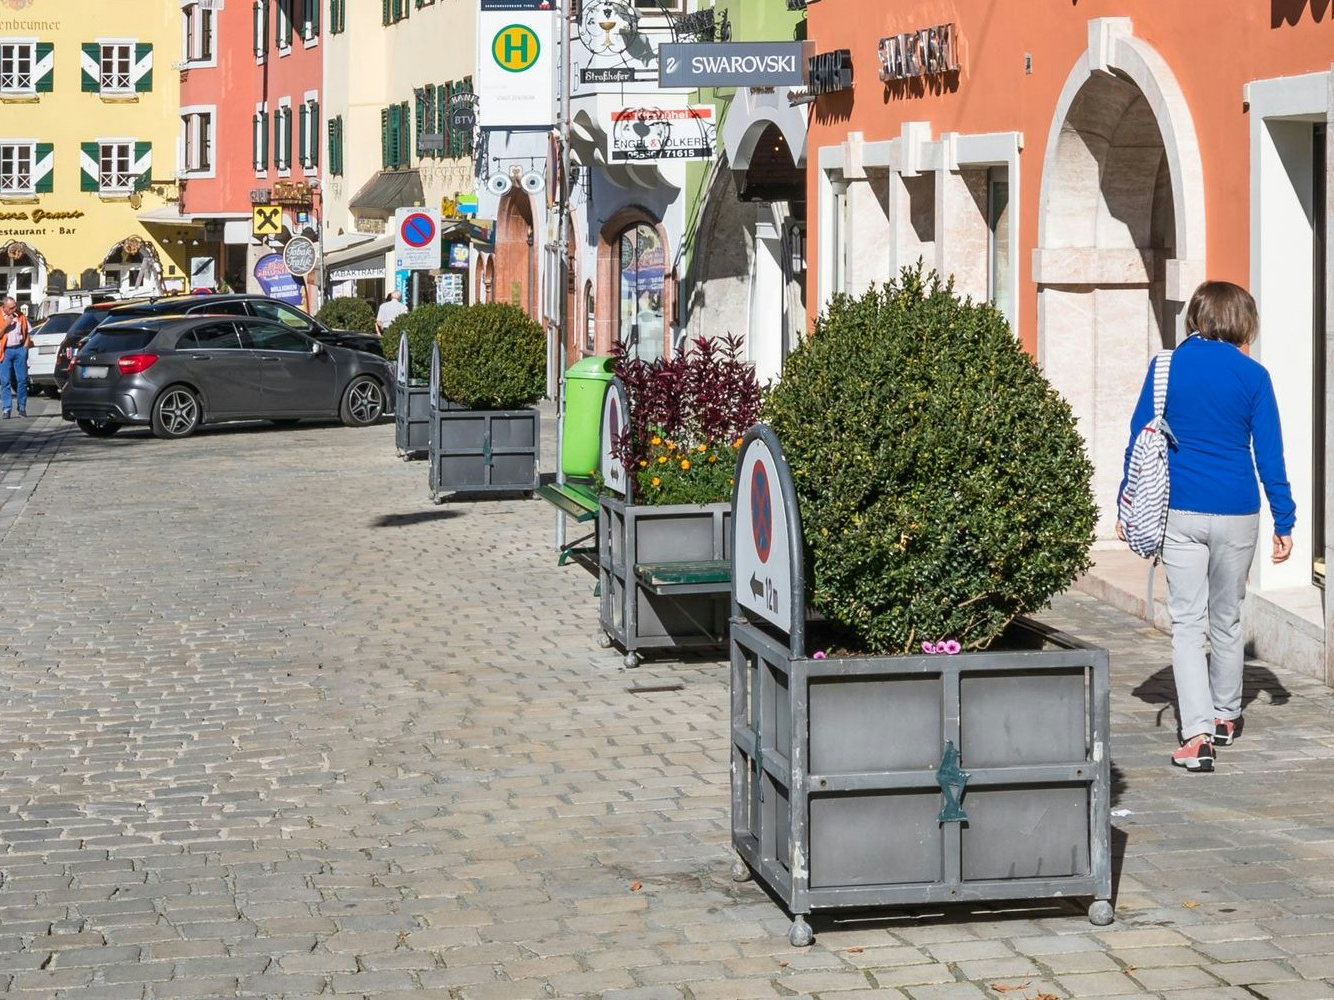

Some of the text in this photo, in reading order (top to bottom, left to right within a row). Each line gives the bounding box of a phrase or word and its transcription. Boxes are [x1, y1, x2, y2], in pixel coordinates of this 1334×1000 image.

[504, 33, 527, 63] H
[692, 56, 795, 73] SWAROVSKI
[585, 71, 630, 82] Straßhofer
[454, 116, 474, 124] BTV
[614, 139, 648, 149] ENGEL
[650, 139, 657, 148] &
[59, 227, 76, 235] Bar
[331, 268, 384, 278] TABAKTRAFIK
